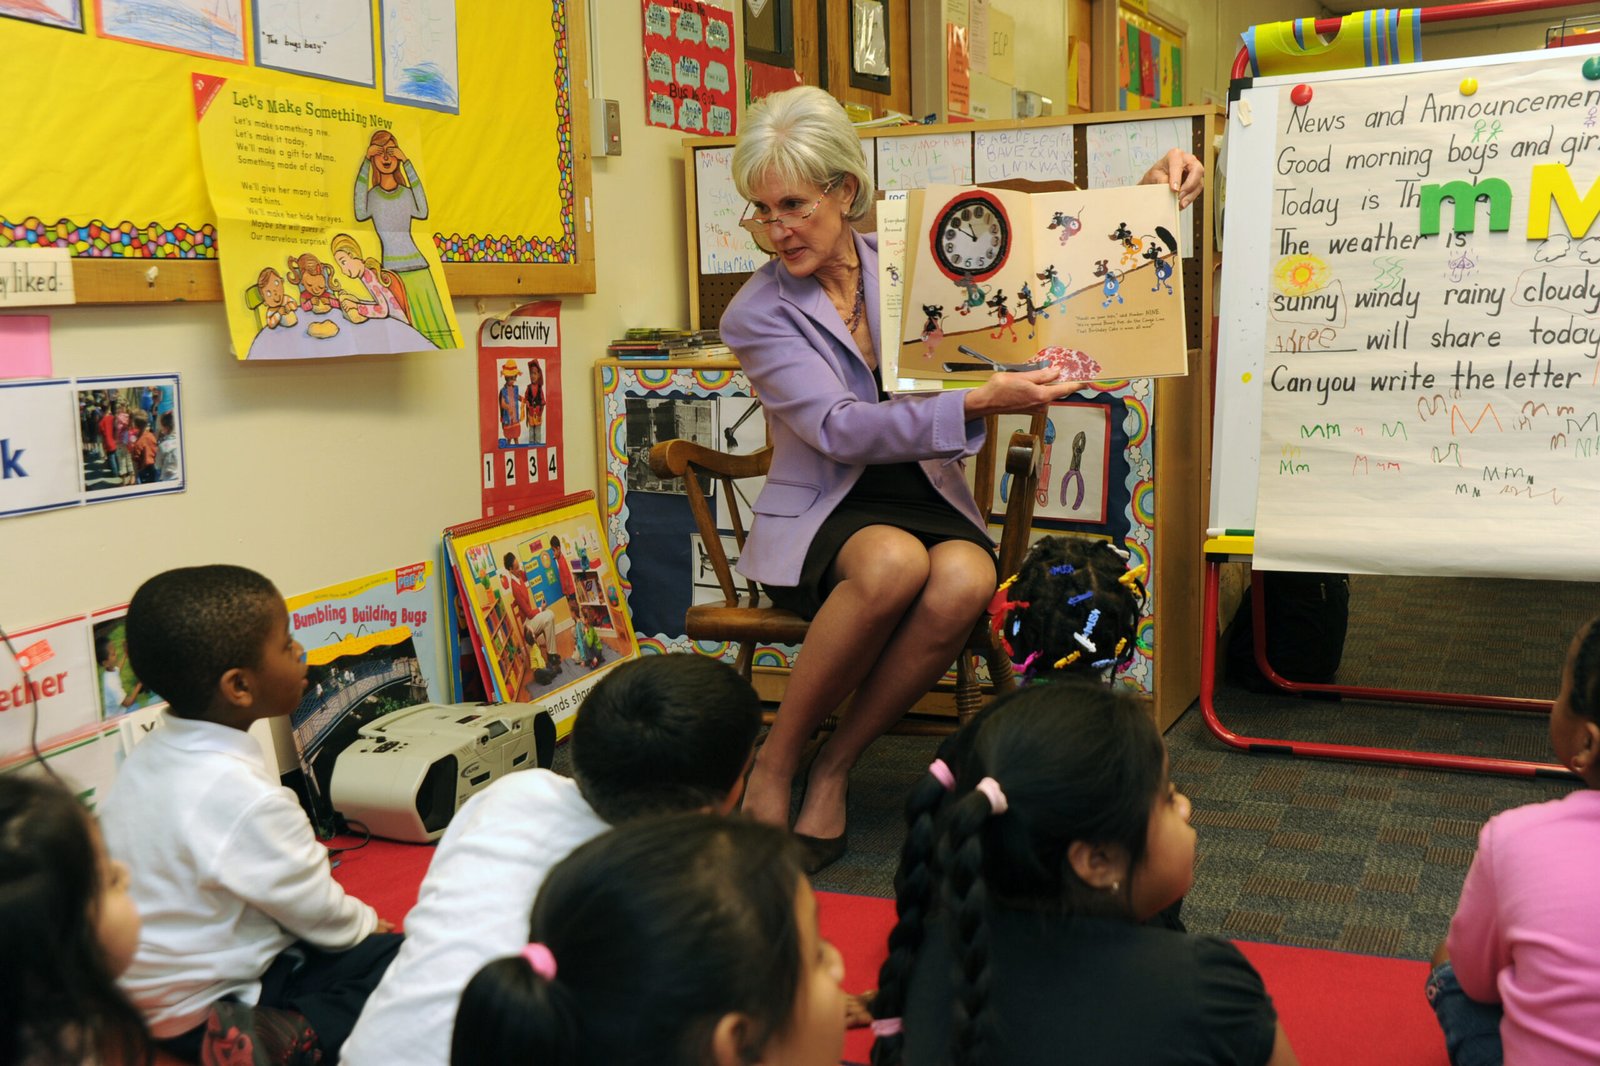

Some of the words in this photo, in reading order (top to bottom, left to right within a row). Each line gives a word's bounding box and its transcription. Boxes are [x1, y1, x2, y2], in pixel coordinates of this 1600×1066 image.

[232, 91, 264, 110] Let's
[266, 99, 302, 116] Make
[305, 101, 367, 128] Something
[369, 114, 393, 130] New
[1286, 106, 1346, 134] News
[1364, 95, 1408, 128] and
[233, 116, 251, 126] Let's
[254, 120, 273, 129] make
[274, 123, 313, 136] something
[235, 129, 253, 139] Let's
[255, 133, 274, 142] make
[284, 137, 308, 148] today.
[258, 146, 275, 155] make
[287, 149, 299, 159] gift
[301, 150, 312, 159] for
[1276, 145, 1332, 176] Good
[1345, 146, 1432, 177] morning
[1447, 133, 1499, 175] boys
[1510, 125, 1555, 158] and
[1561, 131, 1600, 168] gir
[238, 155, 275, 170] Something
[277, 162, 297, 170] made
[300, 163, 307, 171] of
[262, 185, 276, 193] give
[279, 185, 290, 194] her
[1275, 188, 1340, 226] Today
[1361, 189, 1380, 210] is
[251, 219, 274, 230] Maybe
[251, 232, 263, 240] Our
[265, 234, 298, 243] marvelous
[1275, 228, 1310, 256] The
[1329, 222, 1428, 252] weather
[1445, 228, 1467, 248] is
[1273, 294, 1339, 322] sunny
[1354, 278, 1421, 319] windy
[1443, 283, 1506, 316] rainy
[1523, 269, 1600, 314] cloudy
[489, 321, 550, 344] Creativity
[1366, 319, 1409, 350] will
[1431, 319, 1501, 349] share
[1370, 361, 1436, 391] write
[1451, 361, 1495, 390] the
[1504, 359, 1582, 390] letter
[486, 460, 491, 482] 1
[506, 458, 514, 479] 2
[529, 456, 537, 477] 3
[549, 453, 557, 474] 4
[293, 604, 347, 630] Bumbling
[352, 604, 397, 627] Building
[401, 608, 428, 627] Bugs
[544, 696, 570, 716] ends
